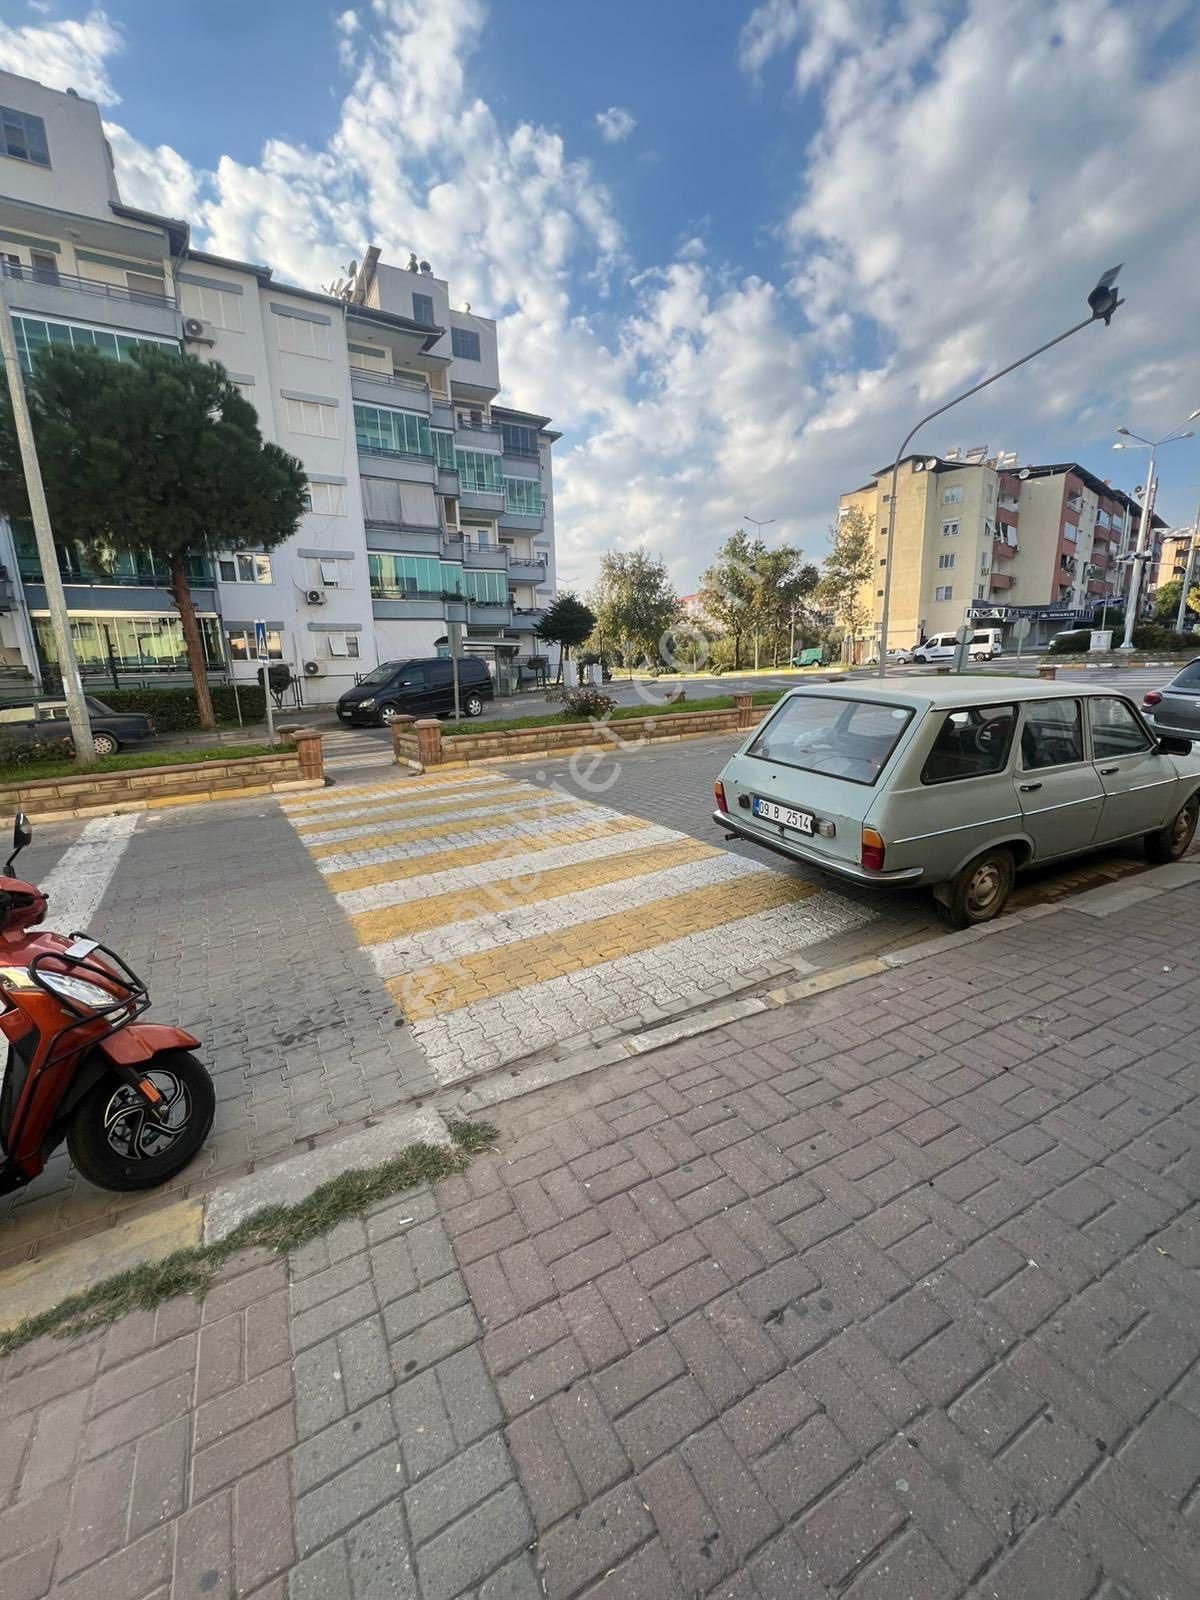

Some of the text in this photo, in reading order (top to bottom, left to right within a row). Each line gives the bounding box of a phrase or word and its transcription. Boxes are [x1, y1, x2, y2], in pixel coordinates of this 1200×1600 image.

[759, 801, 809, 830] 09 B 2514
